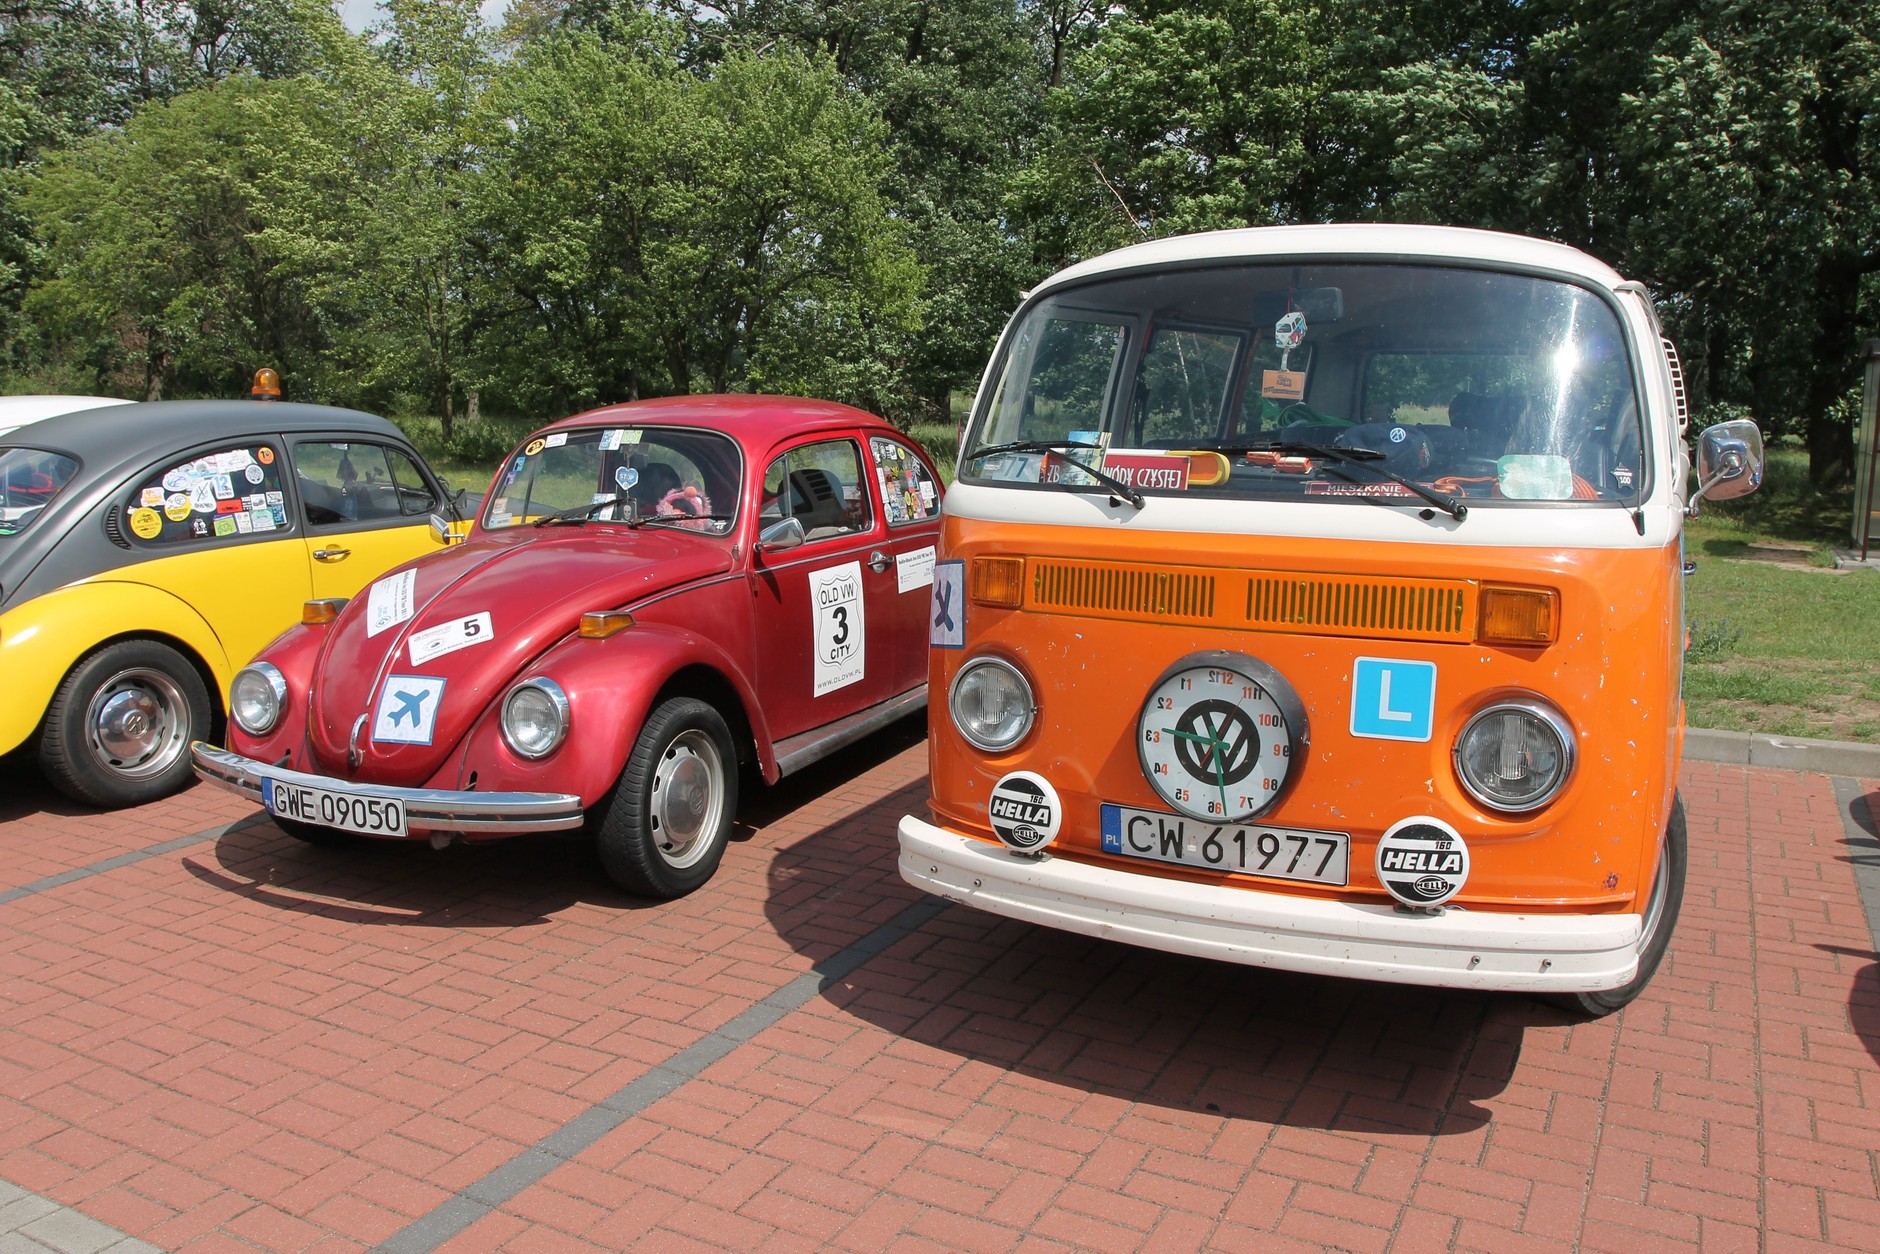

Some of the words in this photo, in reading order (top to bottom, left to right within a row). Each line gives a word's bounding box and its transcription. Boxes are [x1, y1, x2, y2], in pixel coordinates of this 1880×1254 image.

[1137, 468, 1181, 489] CZYSTEJ
[1619, 476, 1631, 484] 100
[1327, 484, 1402, 493] MIESZKANIE
[820, 587, 838, 605] OLD
[840, 583, 854, 600] VW
[463, 618, 480, 637] 5
[832, 606, 849, 645] 3
[830, 643, 851, 660] CITY
[816, 669, 862, 690] WWW.OLDVW.PL
[1186, 678, 1192, 691] 1
[1221, 672, 1233, 685] 12
[1242, 686, 1252, 699] 11
[1378, 669, 1412, 721] L
[1165, 697, 1173, 710] 2
[1258, 713, 1271, 727] 10
[1153, 730, 1160, 743] 3
[1273, 744, 1281, 756] 9
[1160, 763, 1168, 776] 4
[1263, 778, 1270, 790] 8
[1029, 795, 1044, 804] 160
[1182, 789, 1189, 802] 5
[1239, 796, 1246, 808] 7
[274, 785, 316, 821] GWE
[321, 794, 401, 832] 09050
[992, 799, 1050, 824] HELLA
[1214, 801, 1222, 814] 6
[1014, 830, 1039, 840] HELLA
[1105, 835, 1120, 846] PL
[1127, 815, 1184, 859] CW
[1202, 827, 1338, 877] 61977
[1435, 841, 1452, 850] 160
[1383, 851, 1462, 872] HELLA
[1416, 881, 1449, 891] HELLA
